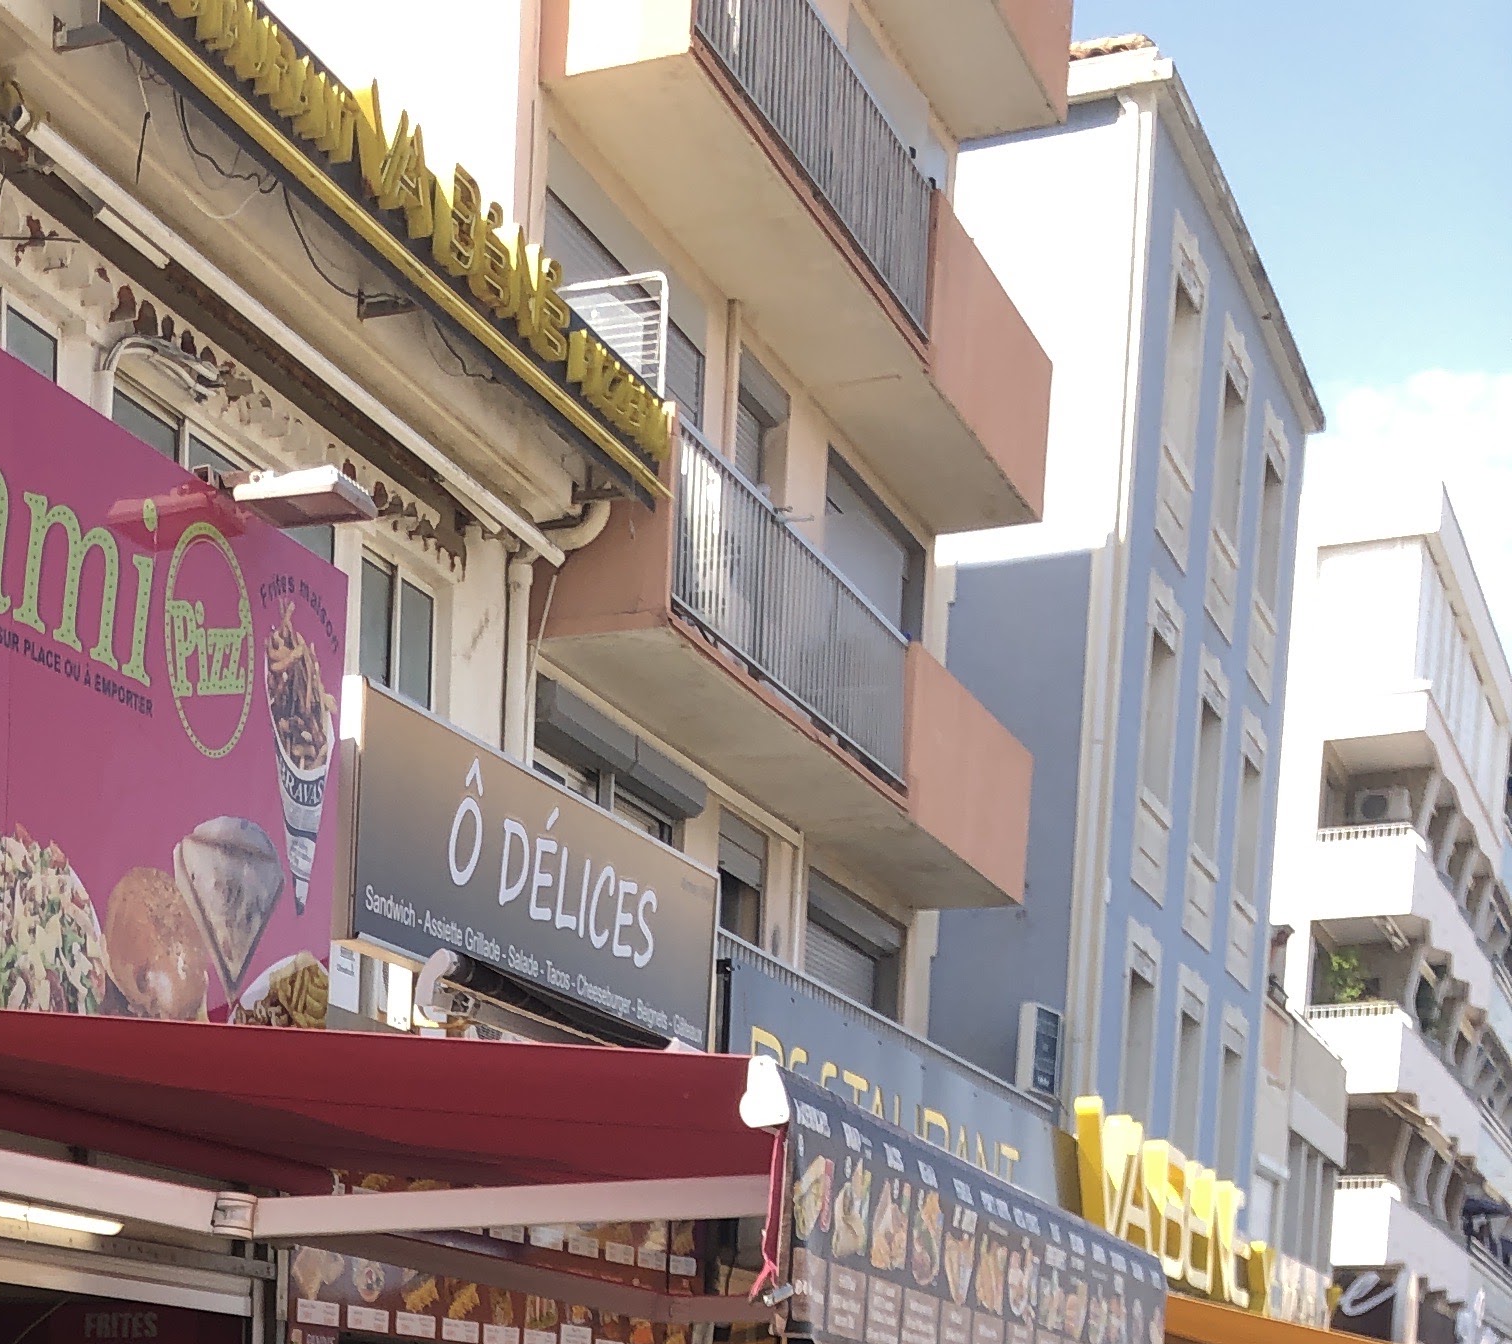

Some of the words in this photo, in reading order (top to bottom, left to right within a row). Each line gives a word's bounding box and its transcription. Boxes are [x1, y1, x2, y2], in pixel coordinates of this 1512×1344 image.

[23, 638, 62, 675] PLACE
[64, 659, 82, 684] OU
[94, 673, 155, 719] EMPORTER
[447, 757, 485, 887] Ô
[497, 807, 658, 970] DÉLICES
[365, 884, 417, 929] Sandwich
[423, 908, 464, 948] Assiette
[465, 926, 502, 963] Grillade
[508, 943, 540, 979] Salade
[545, 959, 571, 992] Tacos
